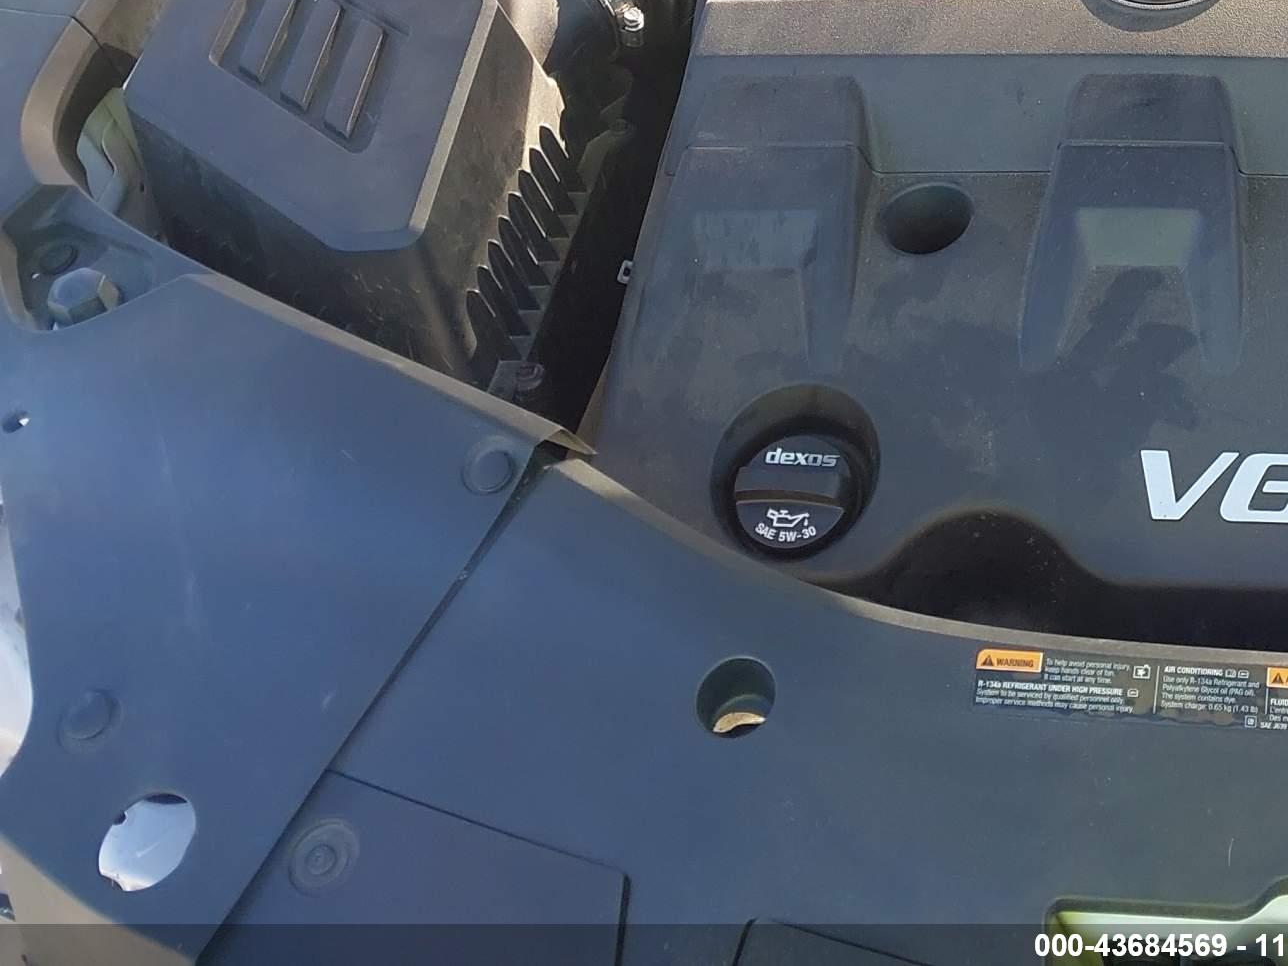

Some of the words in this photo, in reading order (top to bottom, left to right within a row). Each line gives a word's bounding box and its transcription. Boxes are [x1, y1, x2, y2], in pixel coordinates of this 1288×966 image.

[765, 448, 840, 467] dexos
[755, 523, 777, 540] SAE
[778, 526, 817, 542] 5W-30
[996, 658, 1034, 668] WARNING
[1176, 666, 1223, 676] CONDITIONING
[1002, 682, 1046, 691] REFRIGERANT
[1048, 684, 1070, 692] UNDER
[1072, 686, 1088, 694] HIGH
[1089, 686, 1123, 696] PRESSURE
